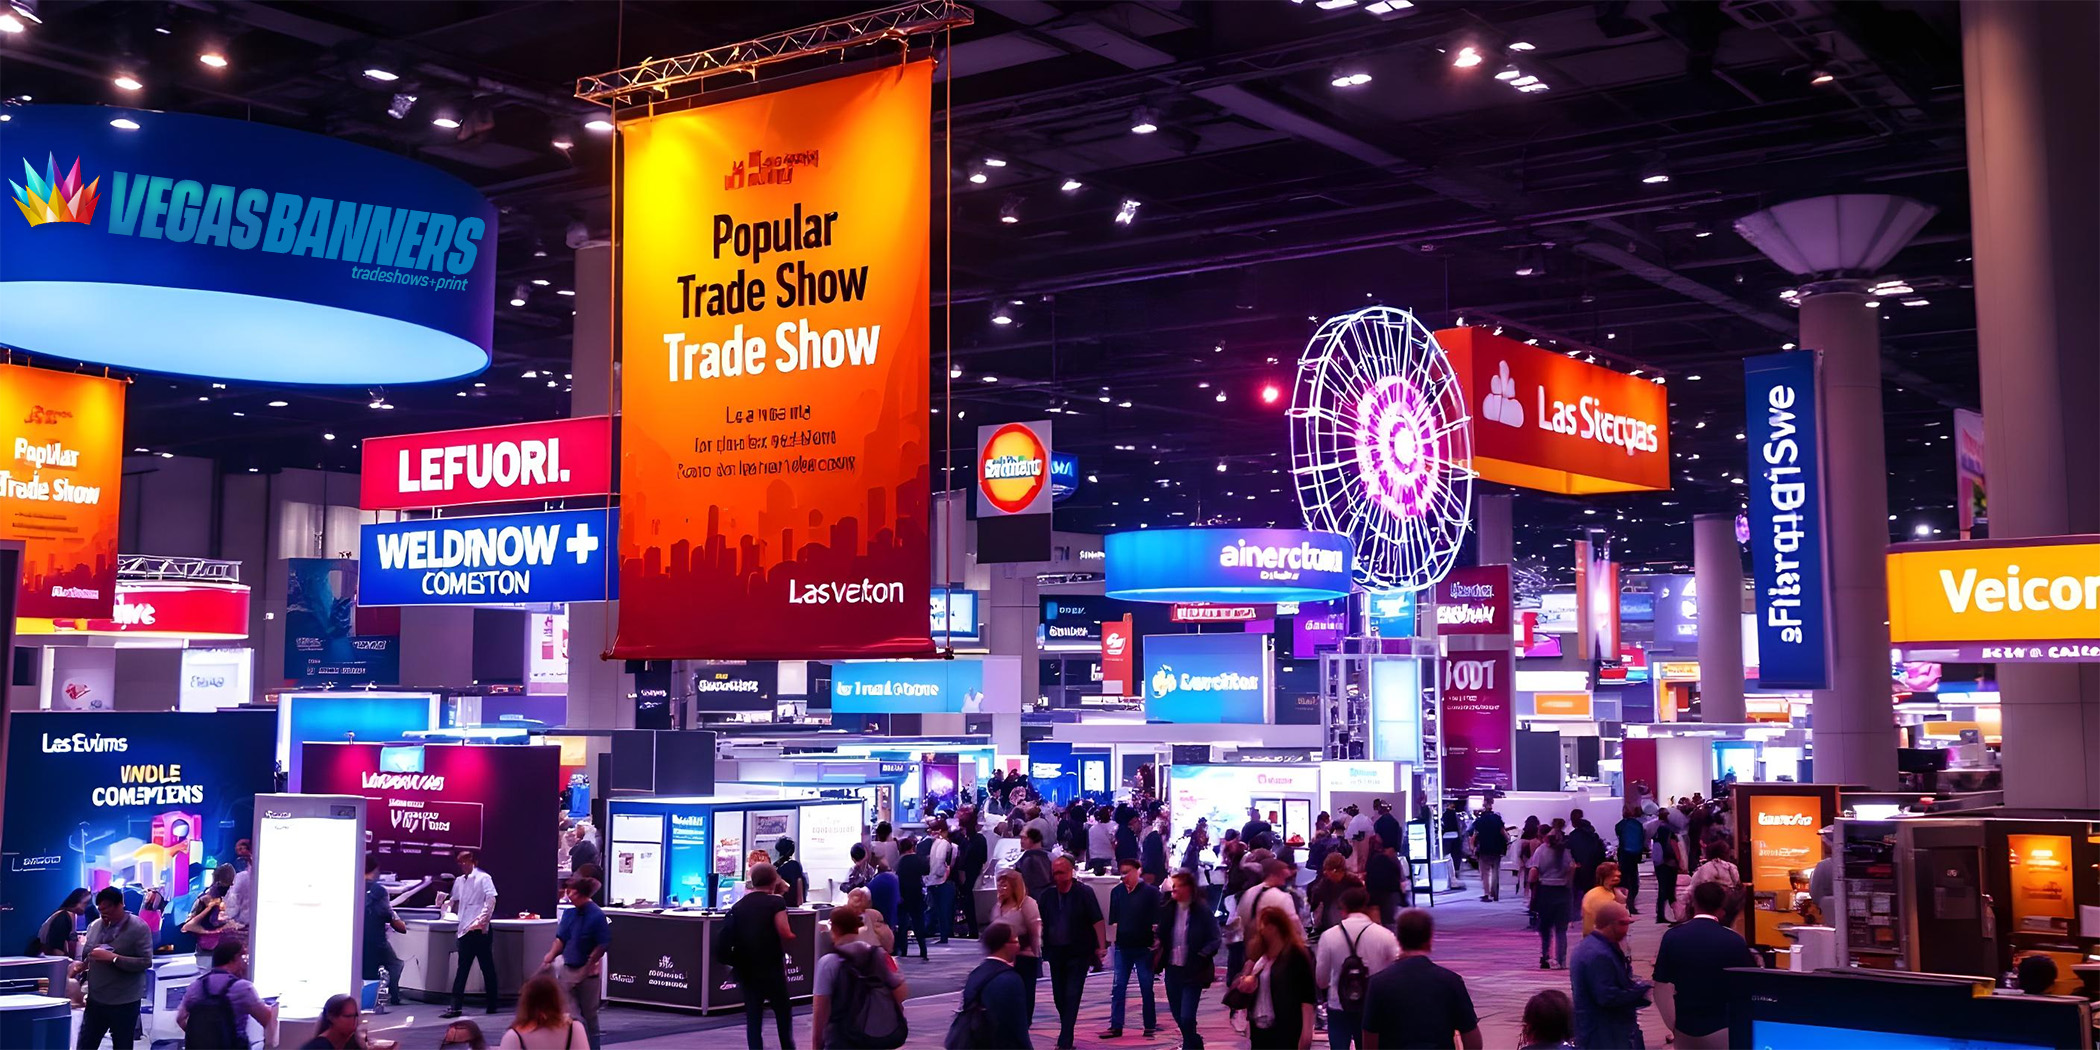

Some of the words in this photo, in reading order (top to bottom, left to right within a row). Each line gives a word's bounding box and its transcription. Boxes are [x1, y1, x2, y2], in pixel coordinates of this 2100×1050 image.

[713, 203, 838, 263] Popular
[351, 265, 469, 292] tradeshows+print
[677, 269, 765, 318] Trade
[776, 261, 868, 309] Show
[663, 324, 766, 381] Trade
[775, 318, 880, 374] Show
[1538, 385, 1577, 435] Las
